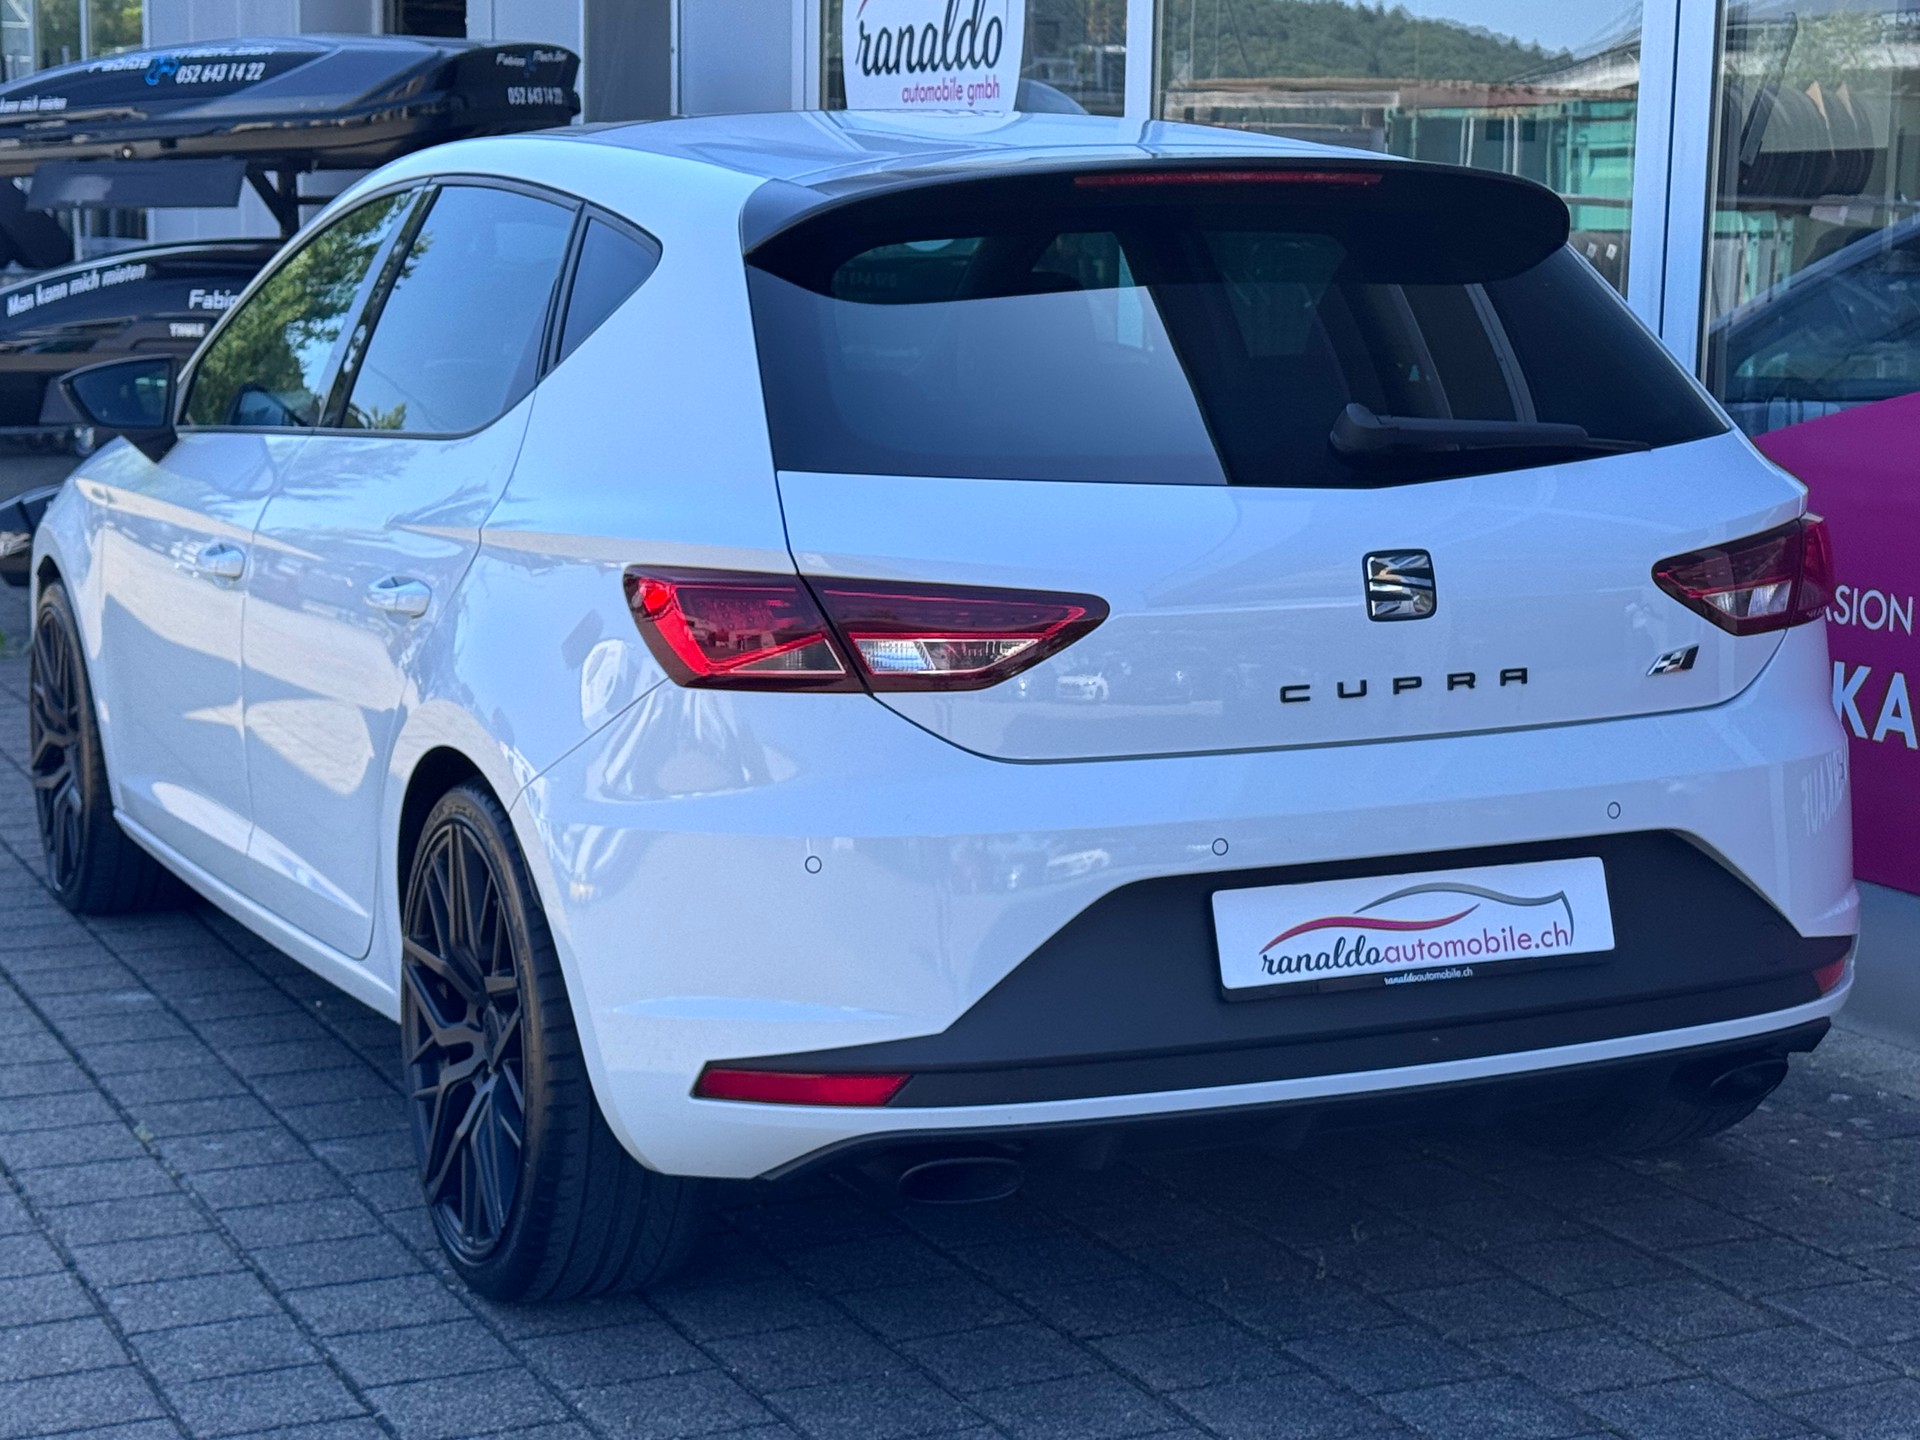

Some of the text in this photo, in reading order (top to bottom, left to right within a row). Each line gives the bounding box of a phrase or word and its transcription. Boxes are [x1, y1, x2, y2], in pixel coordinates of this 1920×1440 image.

[855, 0, 1003, 76] ranaldo
[175, 62, 266, 85] 052 643 14 22
[902, 74, 1000, 106] automobile gmbh
[7, 263, 147, 317] Man kann mich mieten
[1826, 584, 1914, 636] SION
[1279, 666, 1529, 704] CUPRA
[1260, 921, 1570, 976] ranaldoautomobile.ch
